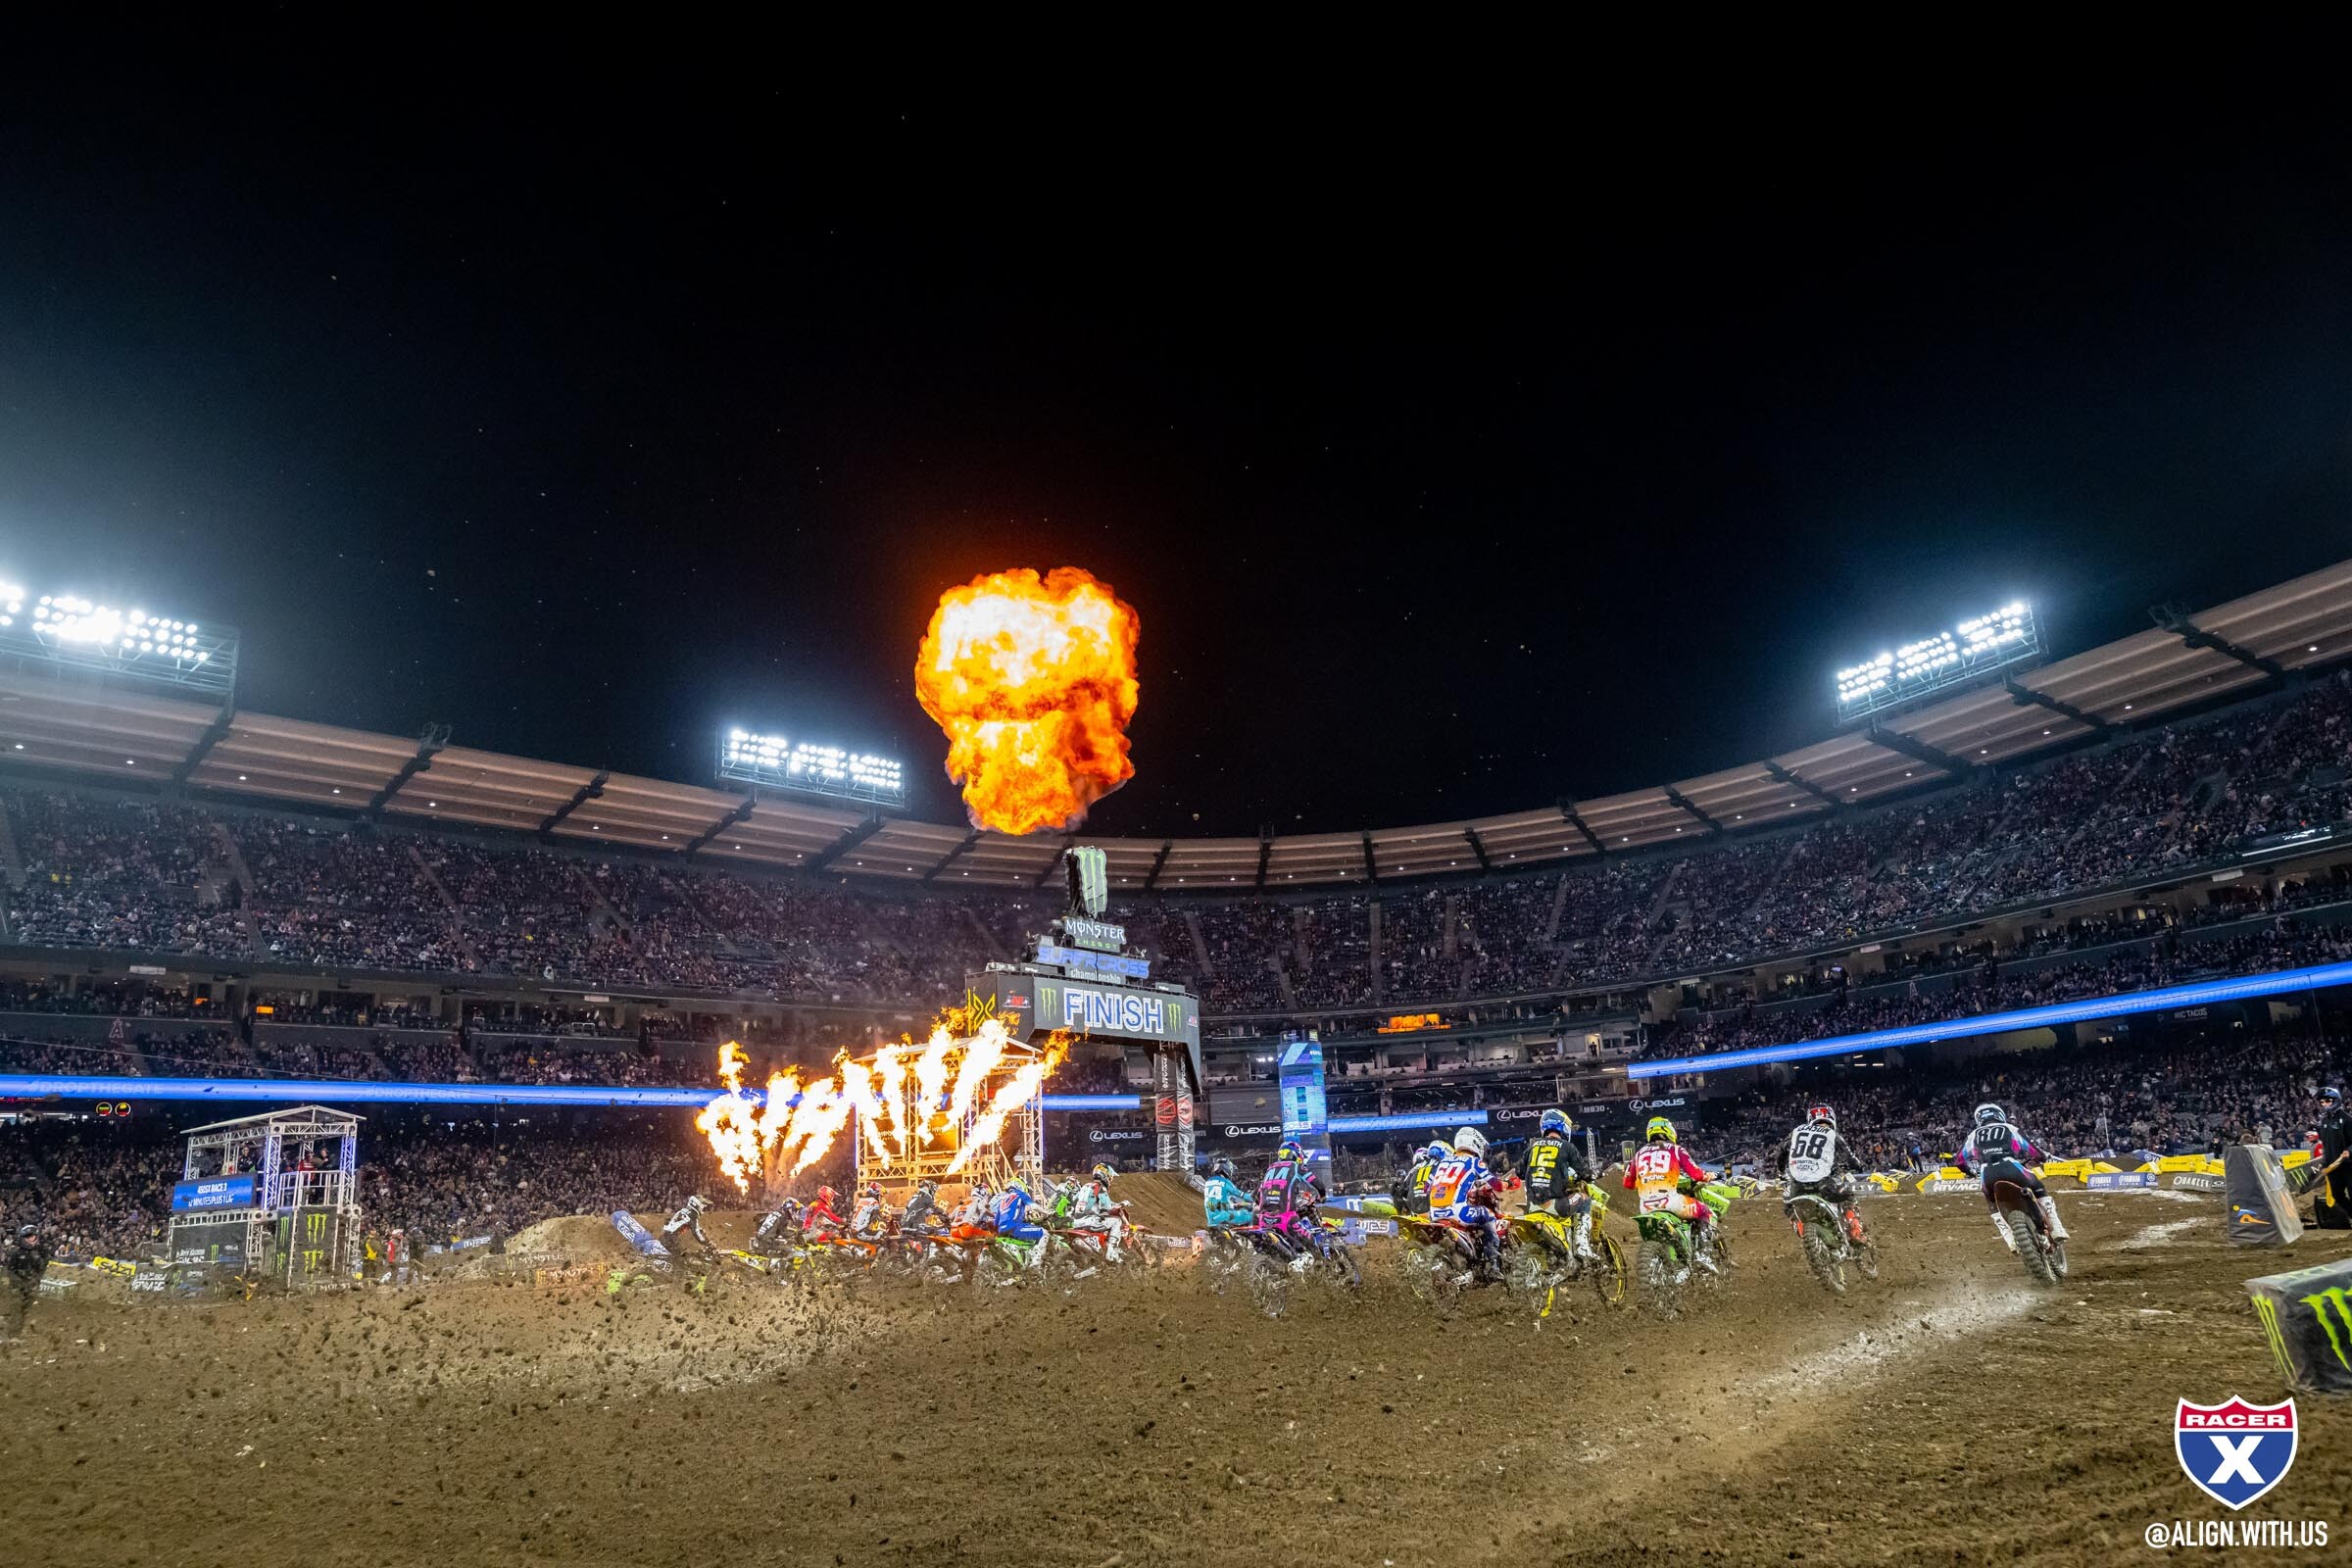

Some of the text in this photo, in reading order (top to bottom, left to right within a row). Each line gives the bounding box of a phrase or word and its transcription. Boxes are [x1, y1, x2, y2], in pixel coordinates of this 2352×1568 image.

[1066, 919, 1127, 945] MONSTER
[1075, 938, 1117, 949] ENERGY
[1036, 946, 1152, 979] SUPERCROSS
[1063, 987, 1164, 1034] FINISH
[1644, 1098, 1685, 1108] LEXUS
[1512, 1109, 1545, 1118] LEXU
[1103, 1131, 1143, 1141] LEXUS
[1240, 1125, 1282, 1136] LEXUS
[1791, 1132, 1828, 1159] 68
[1530, 1146, 1559, 1168] 12
[1638, 1150, 1671, 1177] 519
[1433, 1161, 1466, 1185] 60
[212, 1183, 223, 1194] RACE
[2174, 1175, 2210, 1189] OAKLEY
[211, 1194, 223, 1205] PLUS
